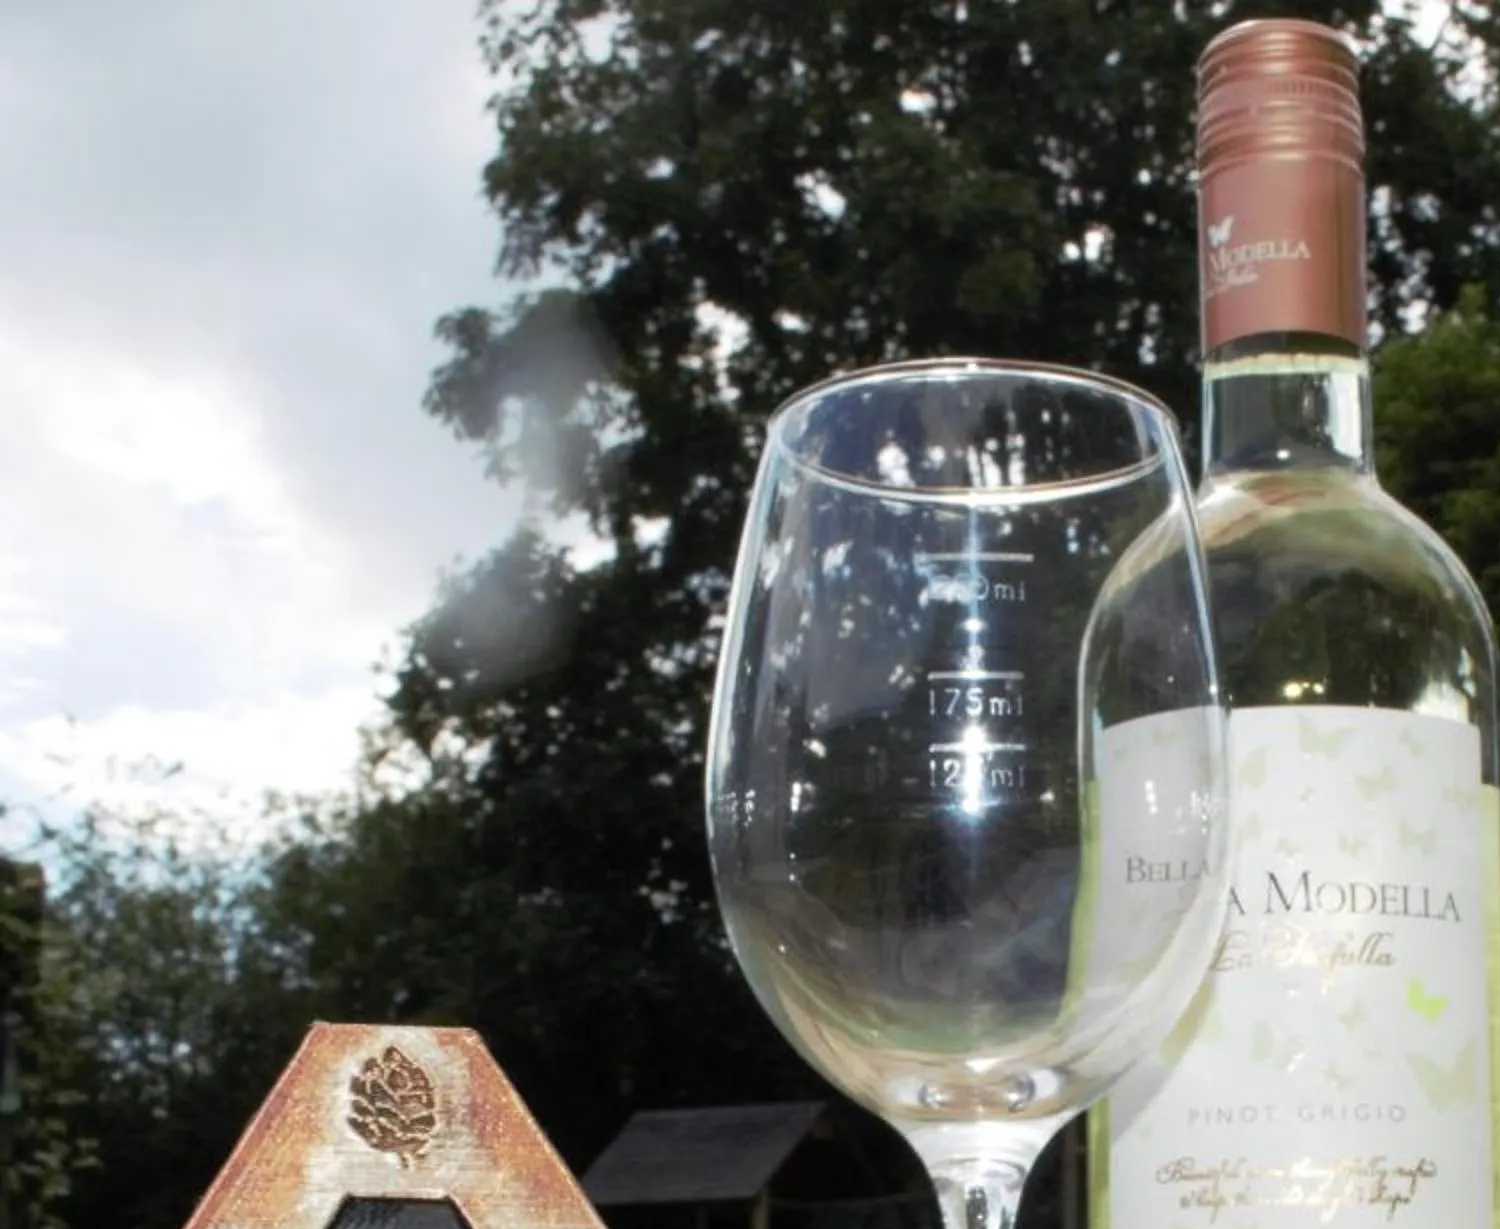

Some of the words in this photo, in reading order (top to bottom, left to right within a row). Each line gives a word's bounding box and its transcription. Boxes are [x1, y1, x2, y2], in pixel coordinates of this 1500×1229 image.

[930, 572, 1026, 602] 0ml
[928, 687, 1024, 716] 175ml
[929, 757, 1026, 789] 12ml
[1263, 869, 1463, 923] MODELLA
[1187, 1103, 1277, 1126] PINOT
[1296, 1102, 1408, 1124] GRIGIO
